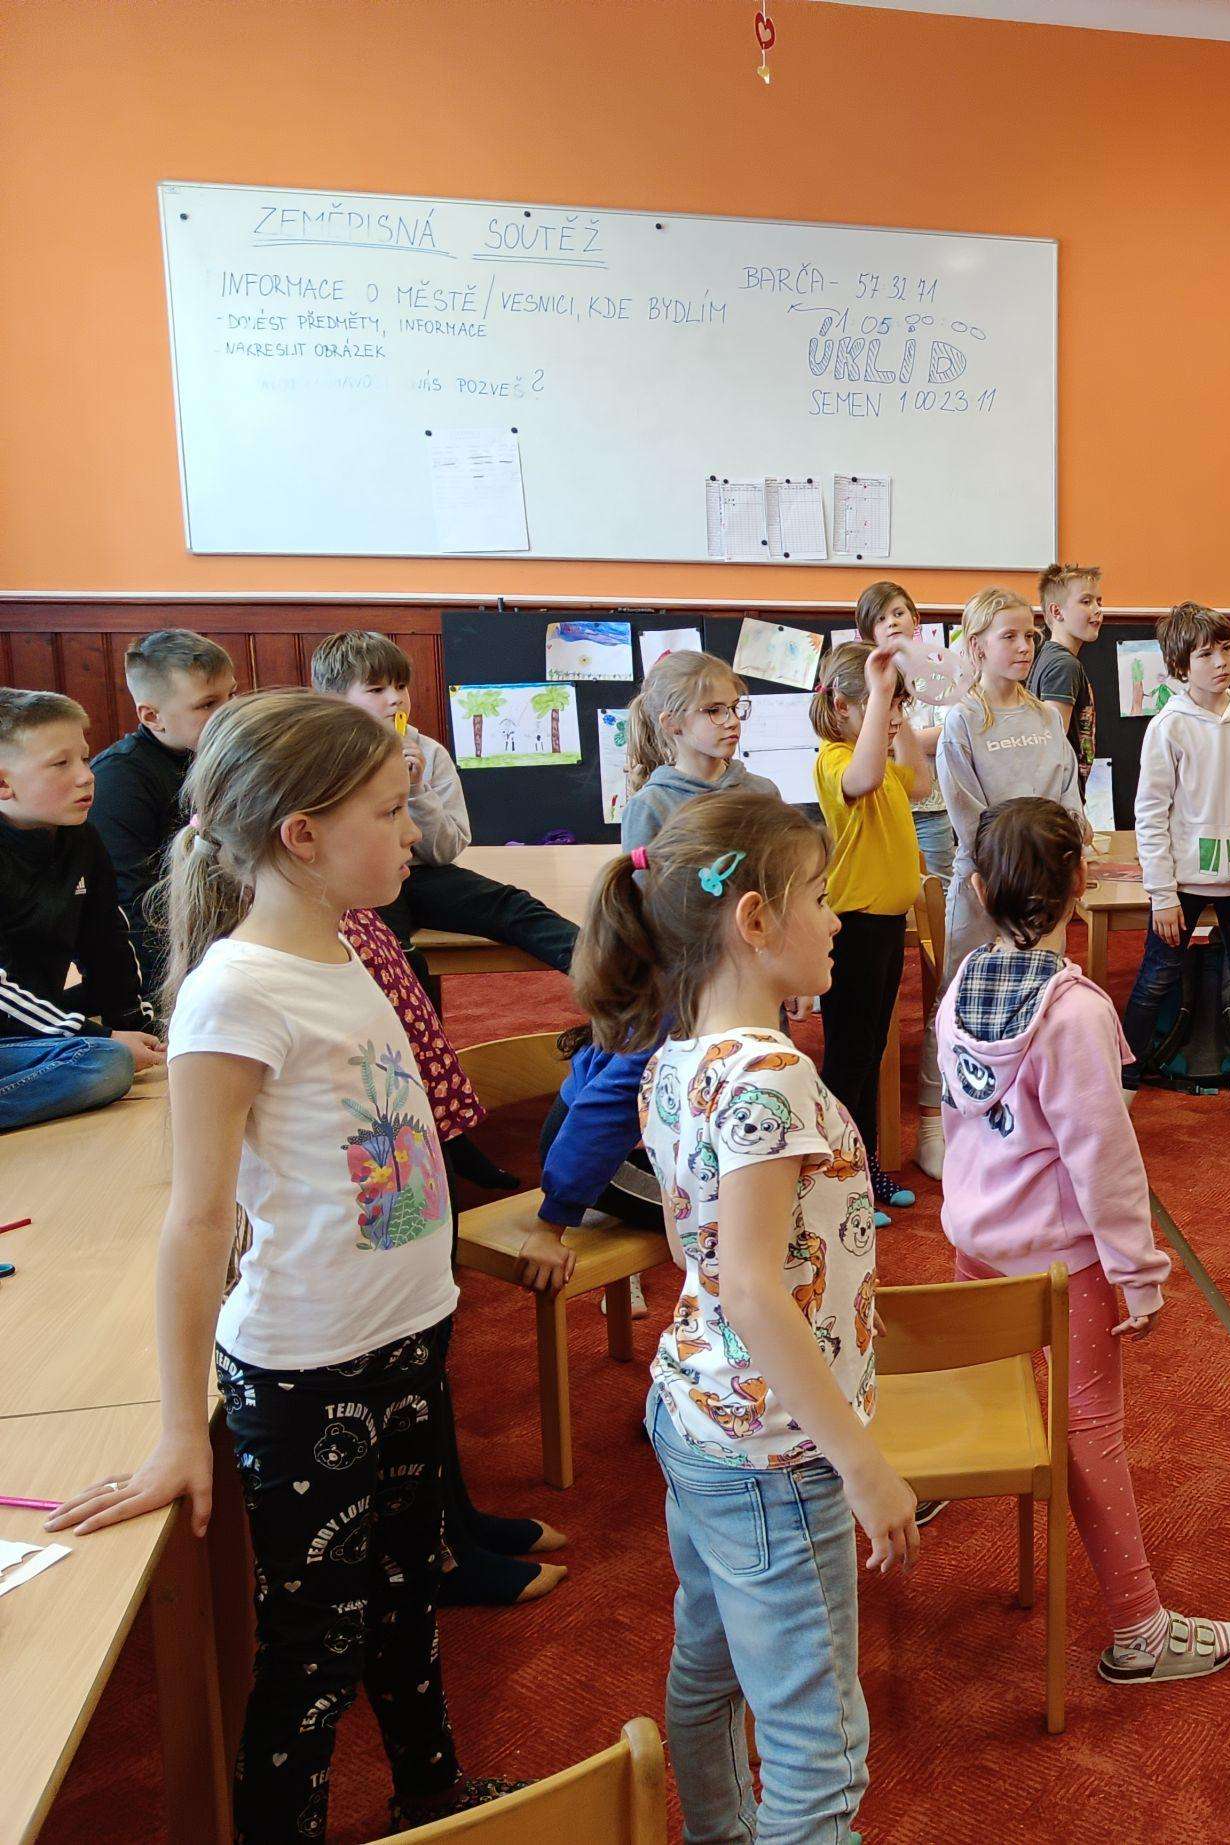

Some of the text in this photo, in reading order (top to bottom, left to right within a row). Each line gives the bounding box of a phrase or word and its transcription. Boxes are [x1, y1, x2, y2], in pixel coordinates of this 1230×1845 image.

[485, 215, 603, 252] SOUTĚŽ
[221, 270, 344, 301] INFORMACE
[366, 283, 379, 303] O
[588, 296, 632, 320] KDE
[649, 288, 727, 324] BYDLÍM
[400, 318, 487, 338] INFORMACE
[314, 338, 386, 359] OBRÁZEK
[809, 389, 881, 417] SEMEN
[325, 1402, 368, 1420] TEDDY
[306, 1518, 340, 1565] TEDDY
